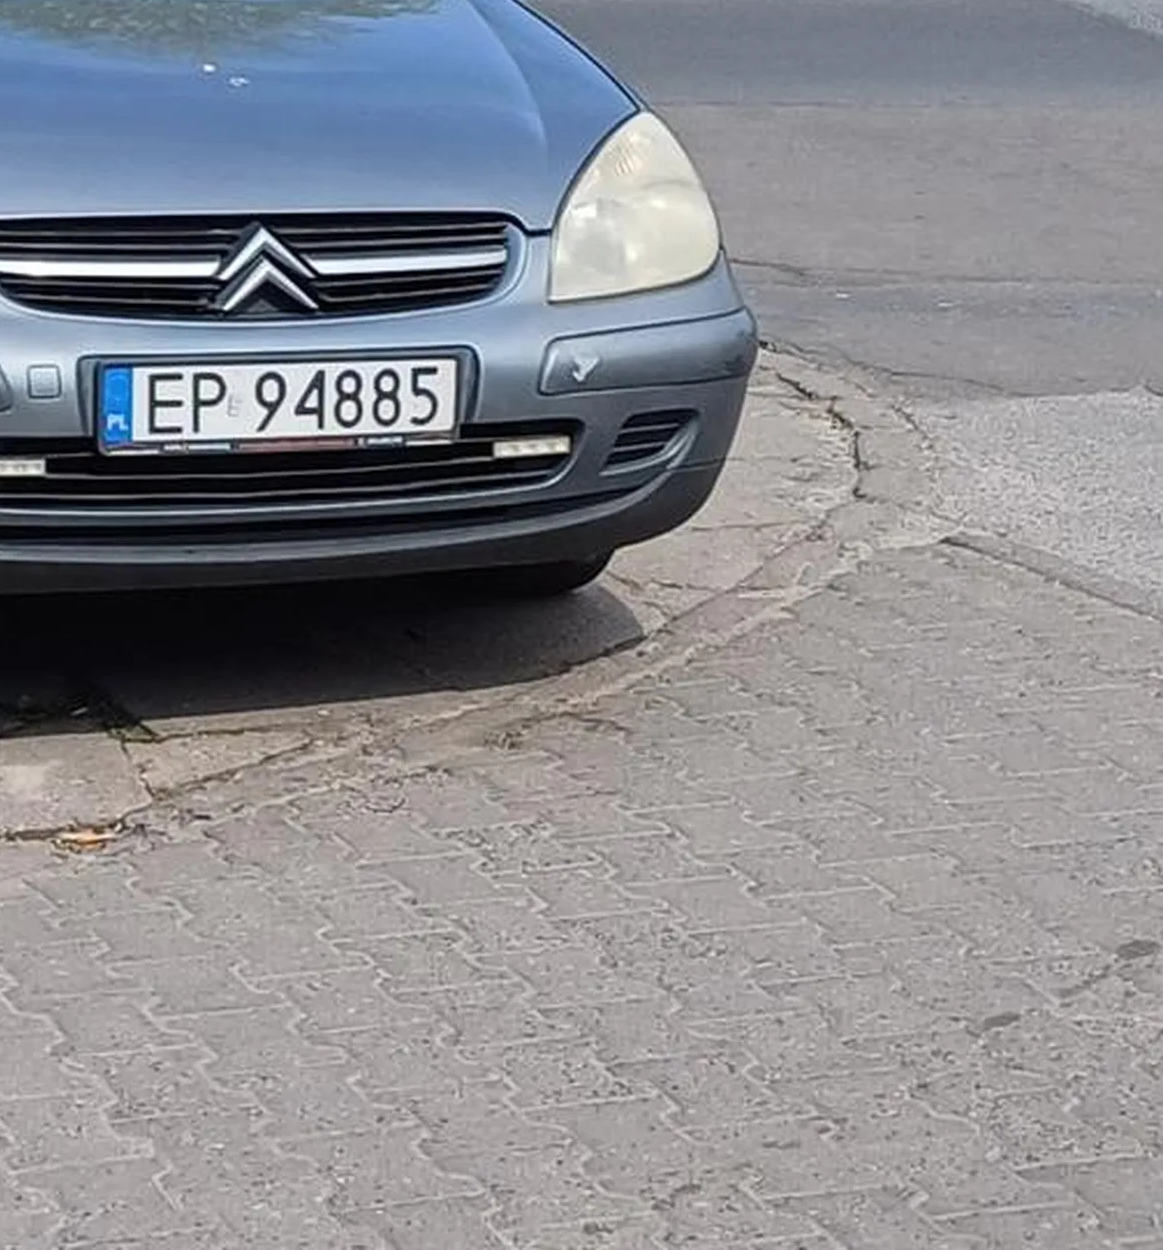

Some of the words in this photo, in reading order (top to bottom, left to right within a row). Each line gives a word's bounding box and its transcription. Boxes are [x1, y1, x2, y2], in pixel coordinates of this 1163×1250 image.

[147, 371, 228, 434] EP
[254, 366, 439, 432] 94885
[106, 413, 129, 432] PL
